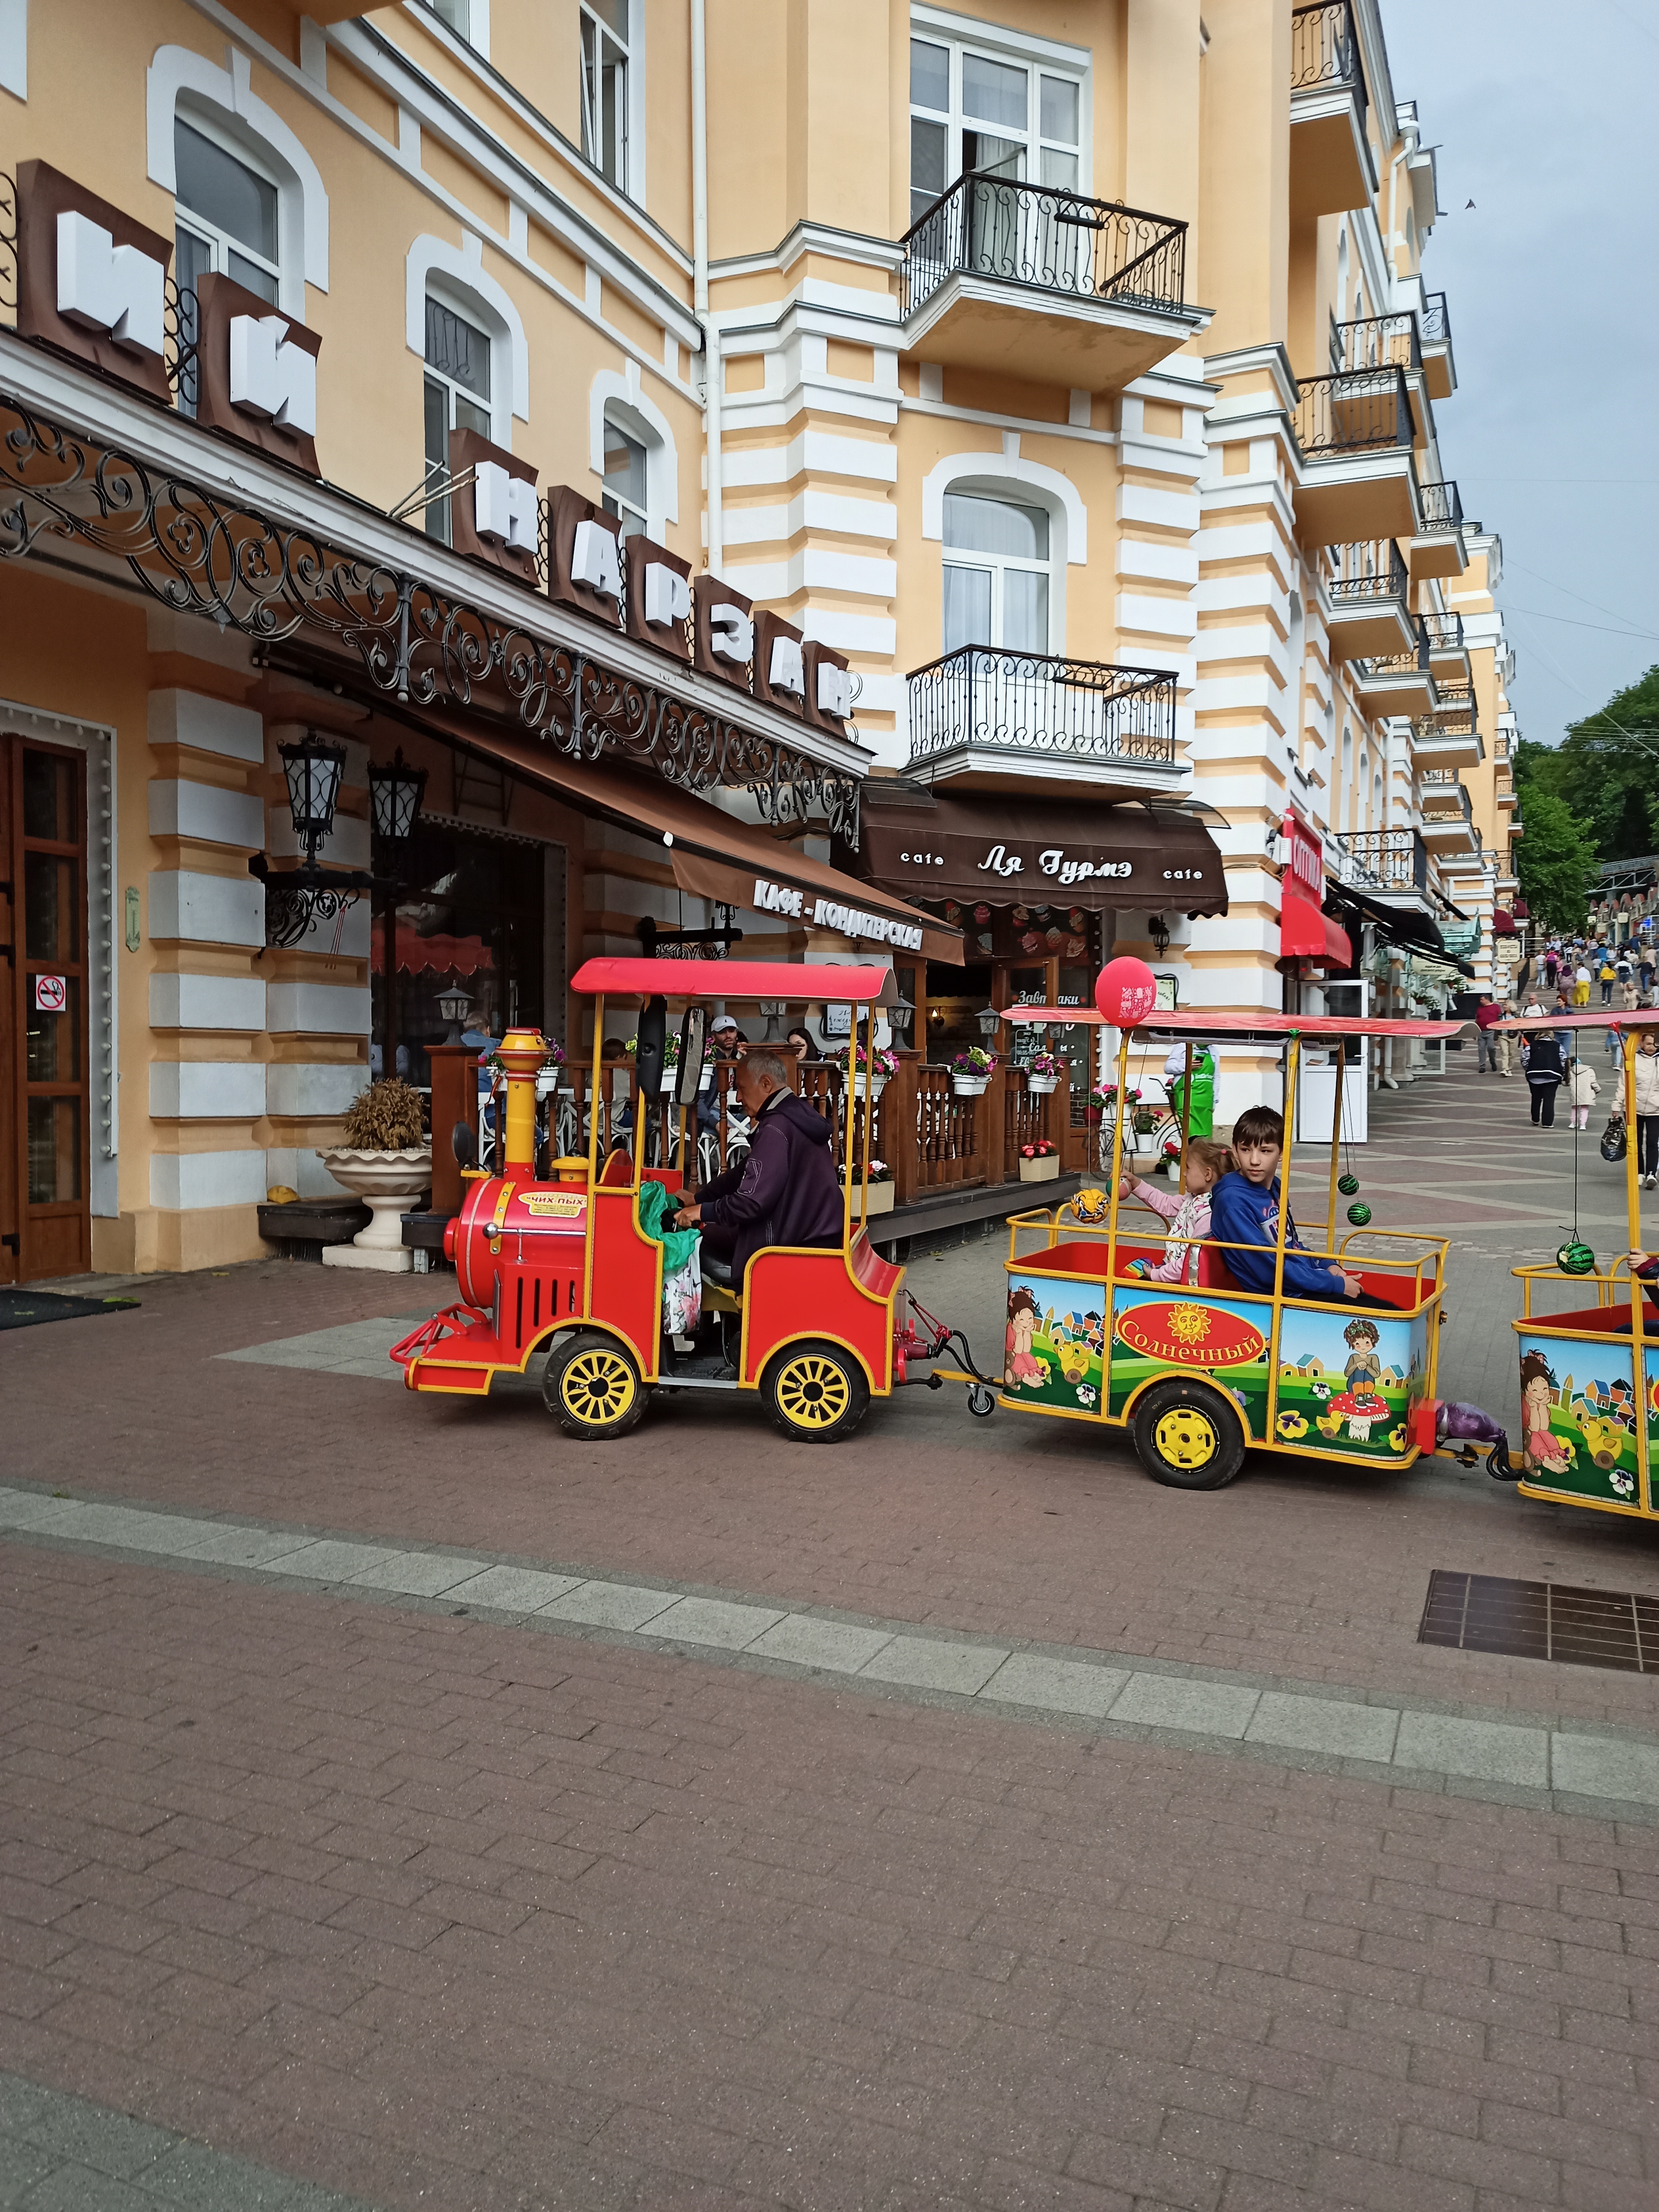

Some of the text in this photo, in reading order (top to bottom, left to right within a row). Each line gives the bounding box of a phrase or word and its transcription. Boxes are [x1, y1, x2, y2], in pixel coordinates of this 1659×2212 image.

[475, 460, 851, 720] НАРЗАН
[900, 852, 945, 866] cafe
[977, 845, 1133, 885] Ля Гурмэ
[1163, 869, 1203, 880] cafe
[1018, 990, 1080, 1005] Завтаки
[1121, 1320, 1262, 1362] Солнечный
